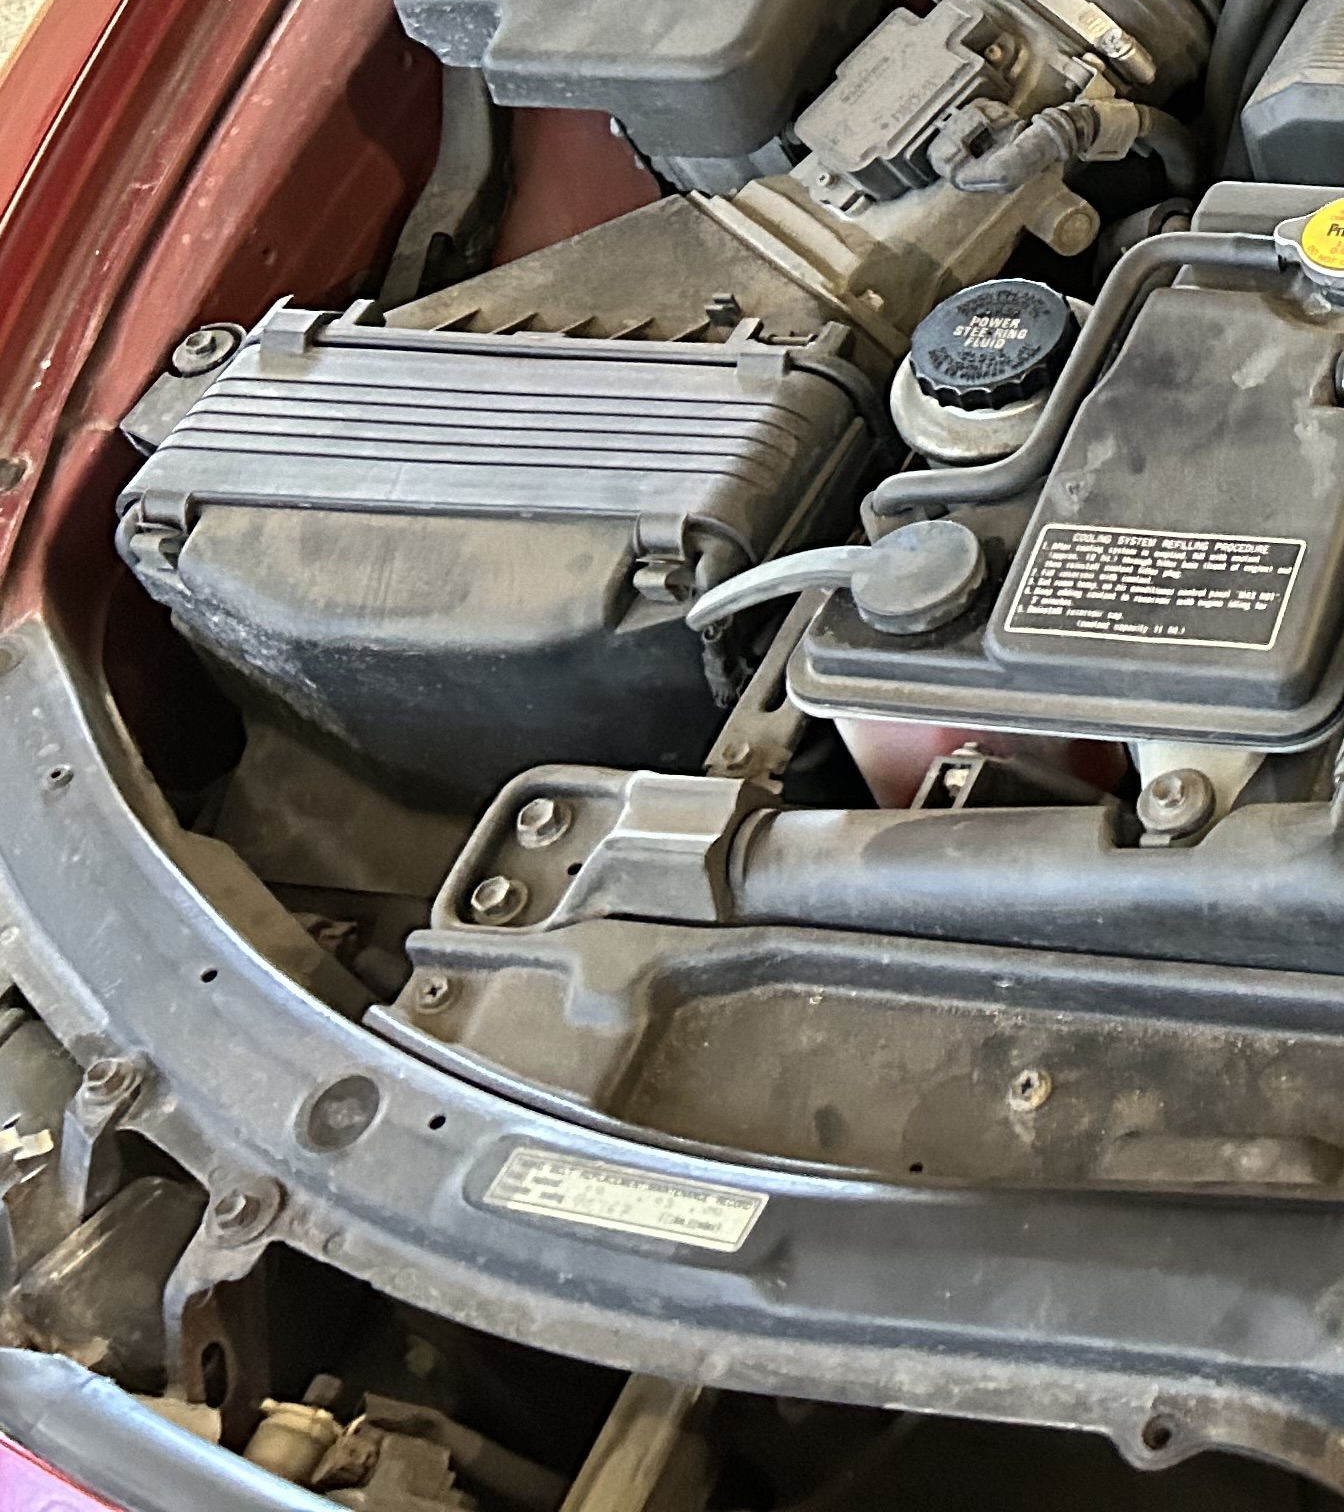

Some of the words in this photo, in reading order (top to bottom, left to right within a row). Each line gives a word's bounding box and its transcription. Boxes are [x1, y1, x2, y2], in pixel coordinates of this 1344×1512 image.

[968, 315, 1021, 330] POWER
[963, 338, 1006, 349] FLUID
[1117, 535, 1158, 548] SYSTEM
[1161, 538, 1210, 551] REFILLING
[1214, 541, 1271, 555] PROCEDURE
